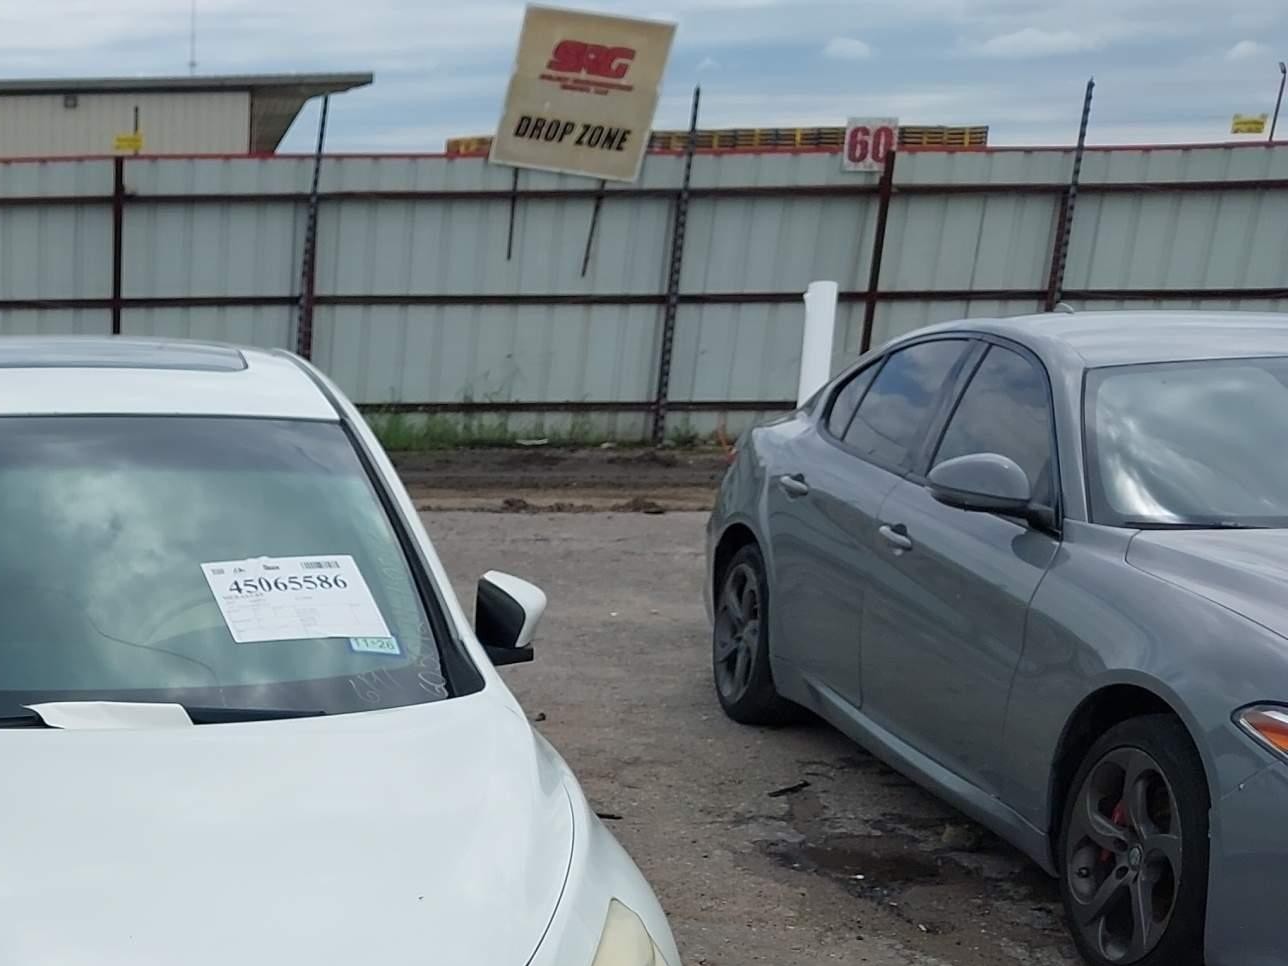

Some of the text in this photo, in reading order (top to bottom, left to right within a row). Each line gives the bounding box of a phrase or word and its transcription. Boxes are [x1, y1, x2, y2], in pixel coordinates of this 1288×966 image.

[514, 115, 631, 151] DROP ZONE
[848, 126, 893, 163] 60
[229, 574, 347, 594] 45065586
